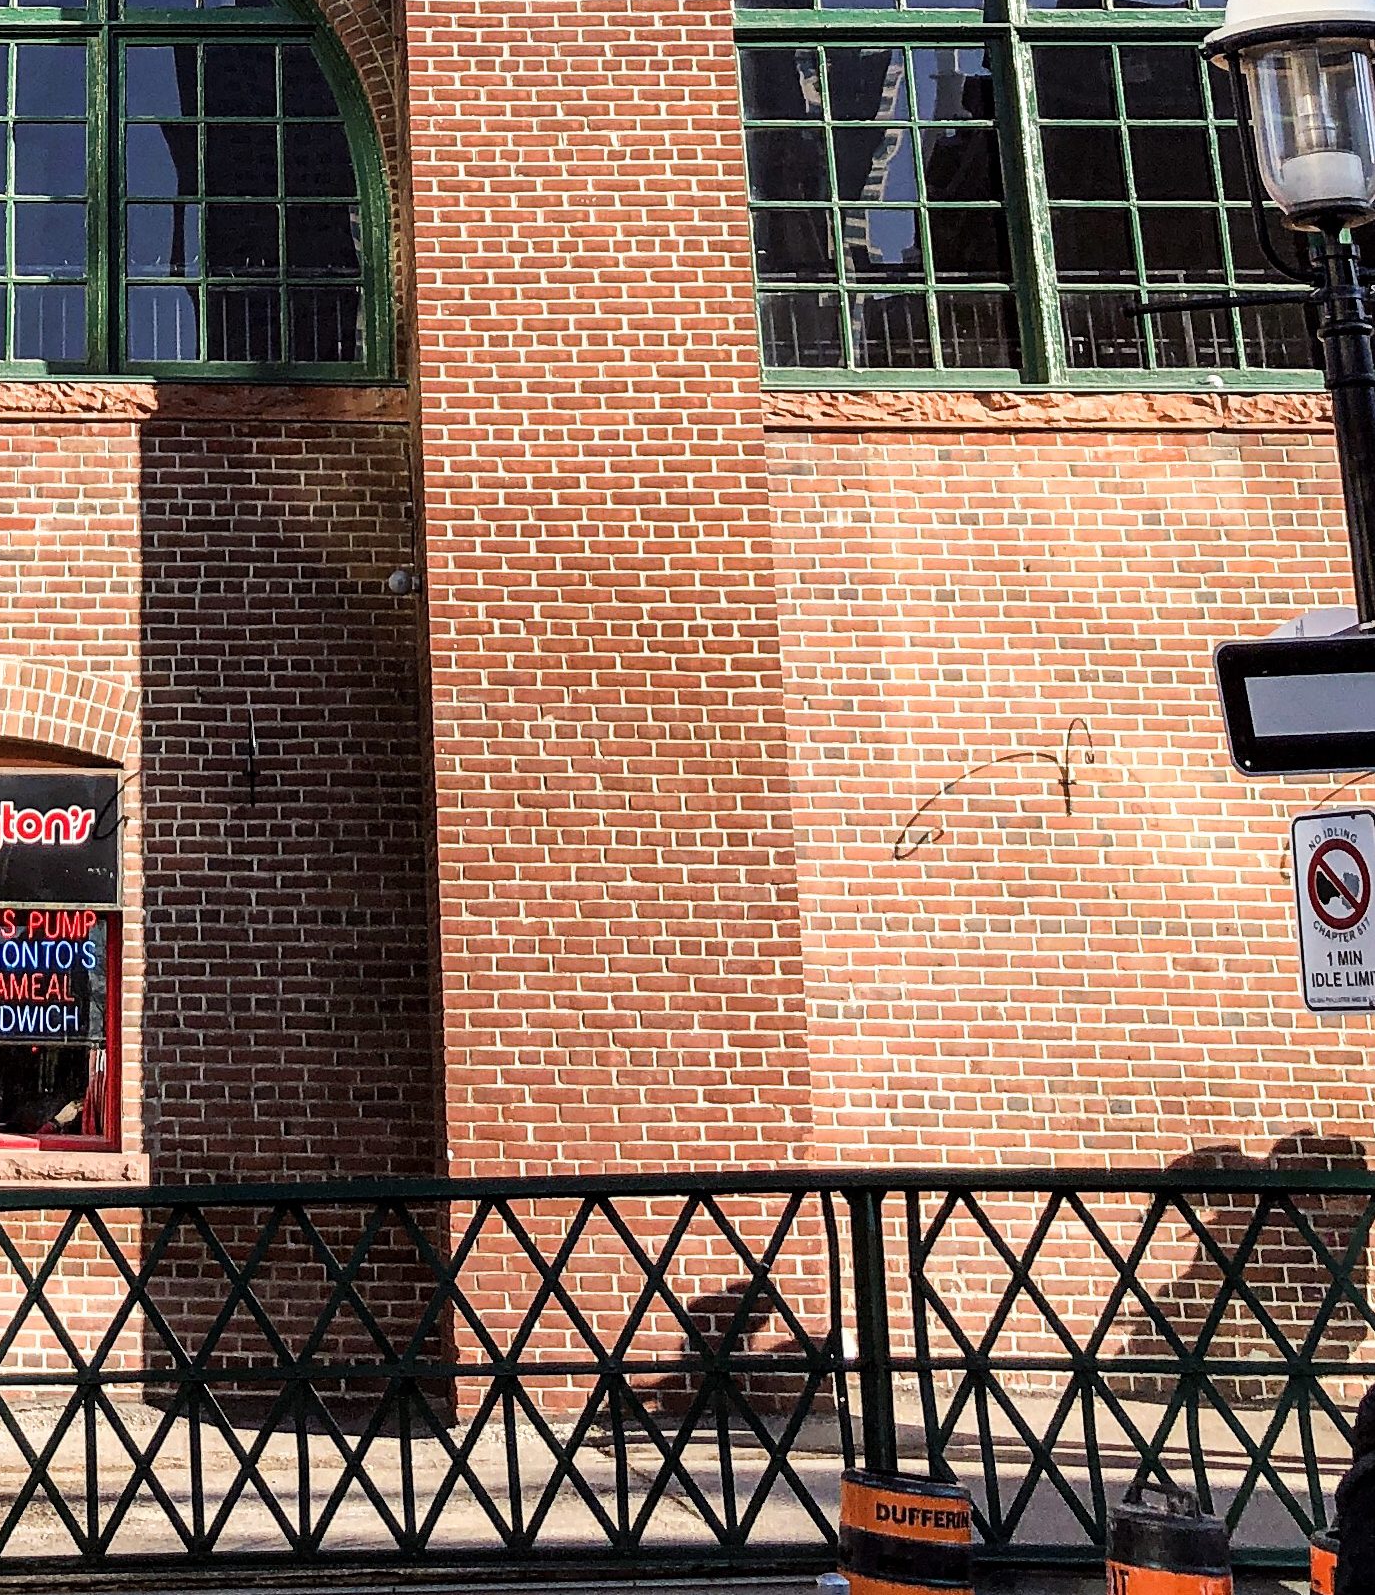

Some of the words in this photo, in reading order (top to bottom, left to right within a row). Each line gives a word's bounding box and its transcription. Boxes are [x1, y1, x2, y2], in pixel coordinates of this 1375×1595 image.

[1308, 834, 1322, 851] NO
[1323, 826, 1358, 844] IDLING
[28, 910, 98, 940] PUMP
[1313, 920, 1356, 943] CHAPTER
[1326, 951, 1333, 966] 1
[1337, 949, 1363, 966] MIN
[1311, 971, 1342, 988] IDLE
[1345, 970, 1375, 987] LIMI
[875, 1501, 969, 1529] DUFFERIN
